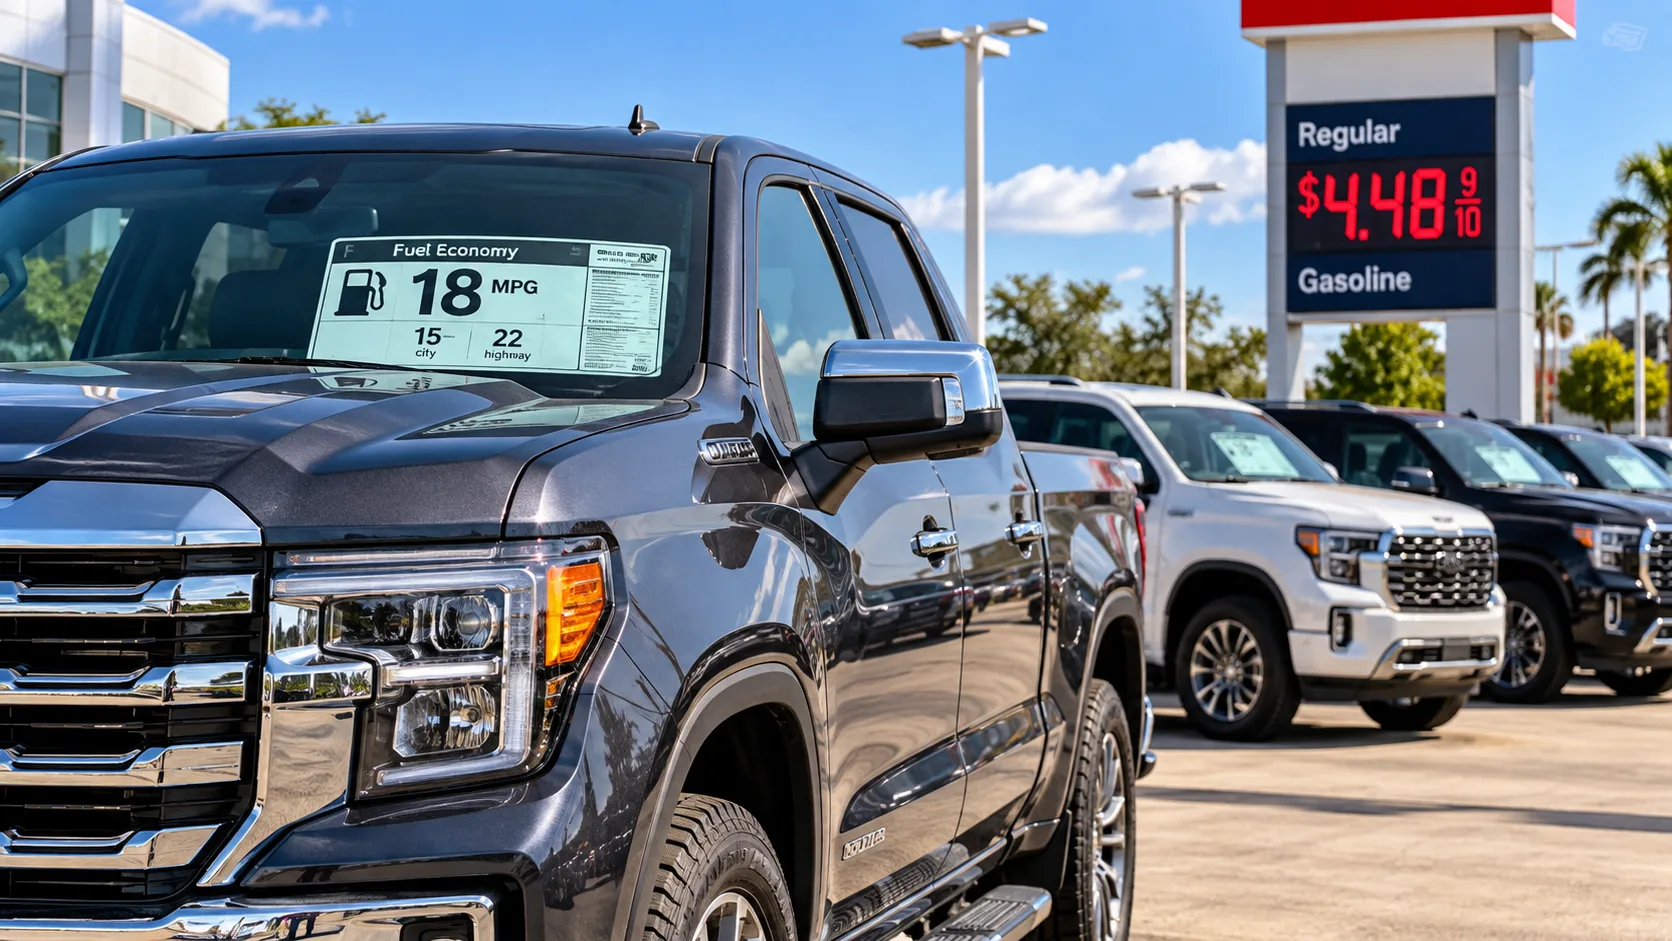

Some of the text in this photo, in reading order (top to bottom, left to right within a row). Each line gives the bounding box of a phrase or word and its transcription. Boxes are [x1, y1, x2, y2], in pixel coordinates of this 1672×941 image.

[1298, 118, 1401, 152] Regular
[1297, 167, 1447, 241] $4.48
[392, 243, 519, 261] Fuel Economy
[1298, 265, 1412, 294] Gasoline
[412, 268, 538, 316] 18 MPG
[415, 327, 442, 346] 15
[493, 328, 522, 348] 22
[415, 348, 436, 360] city
